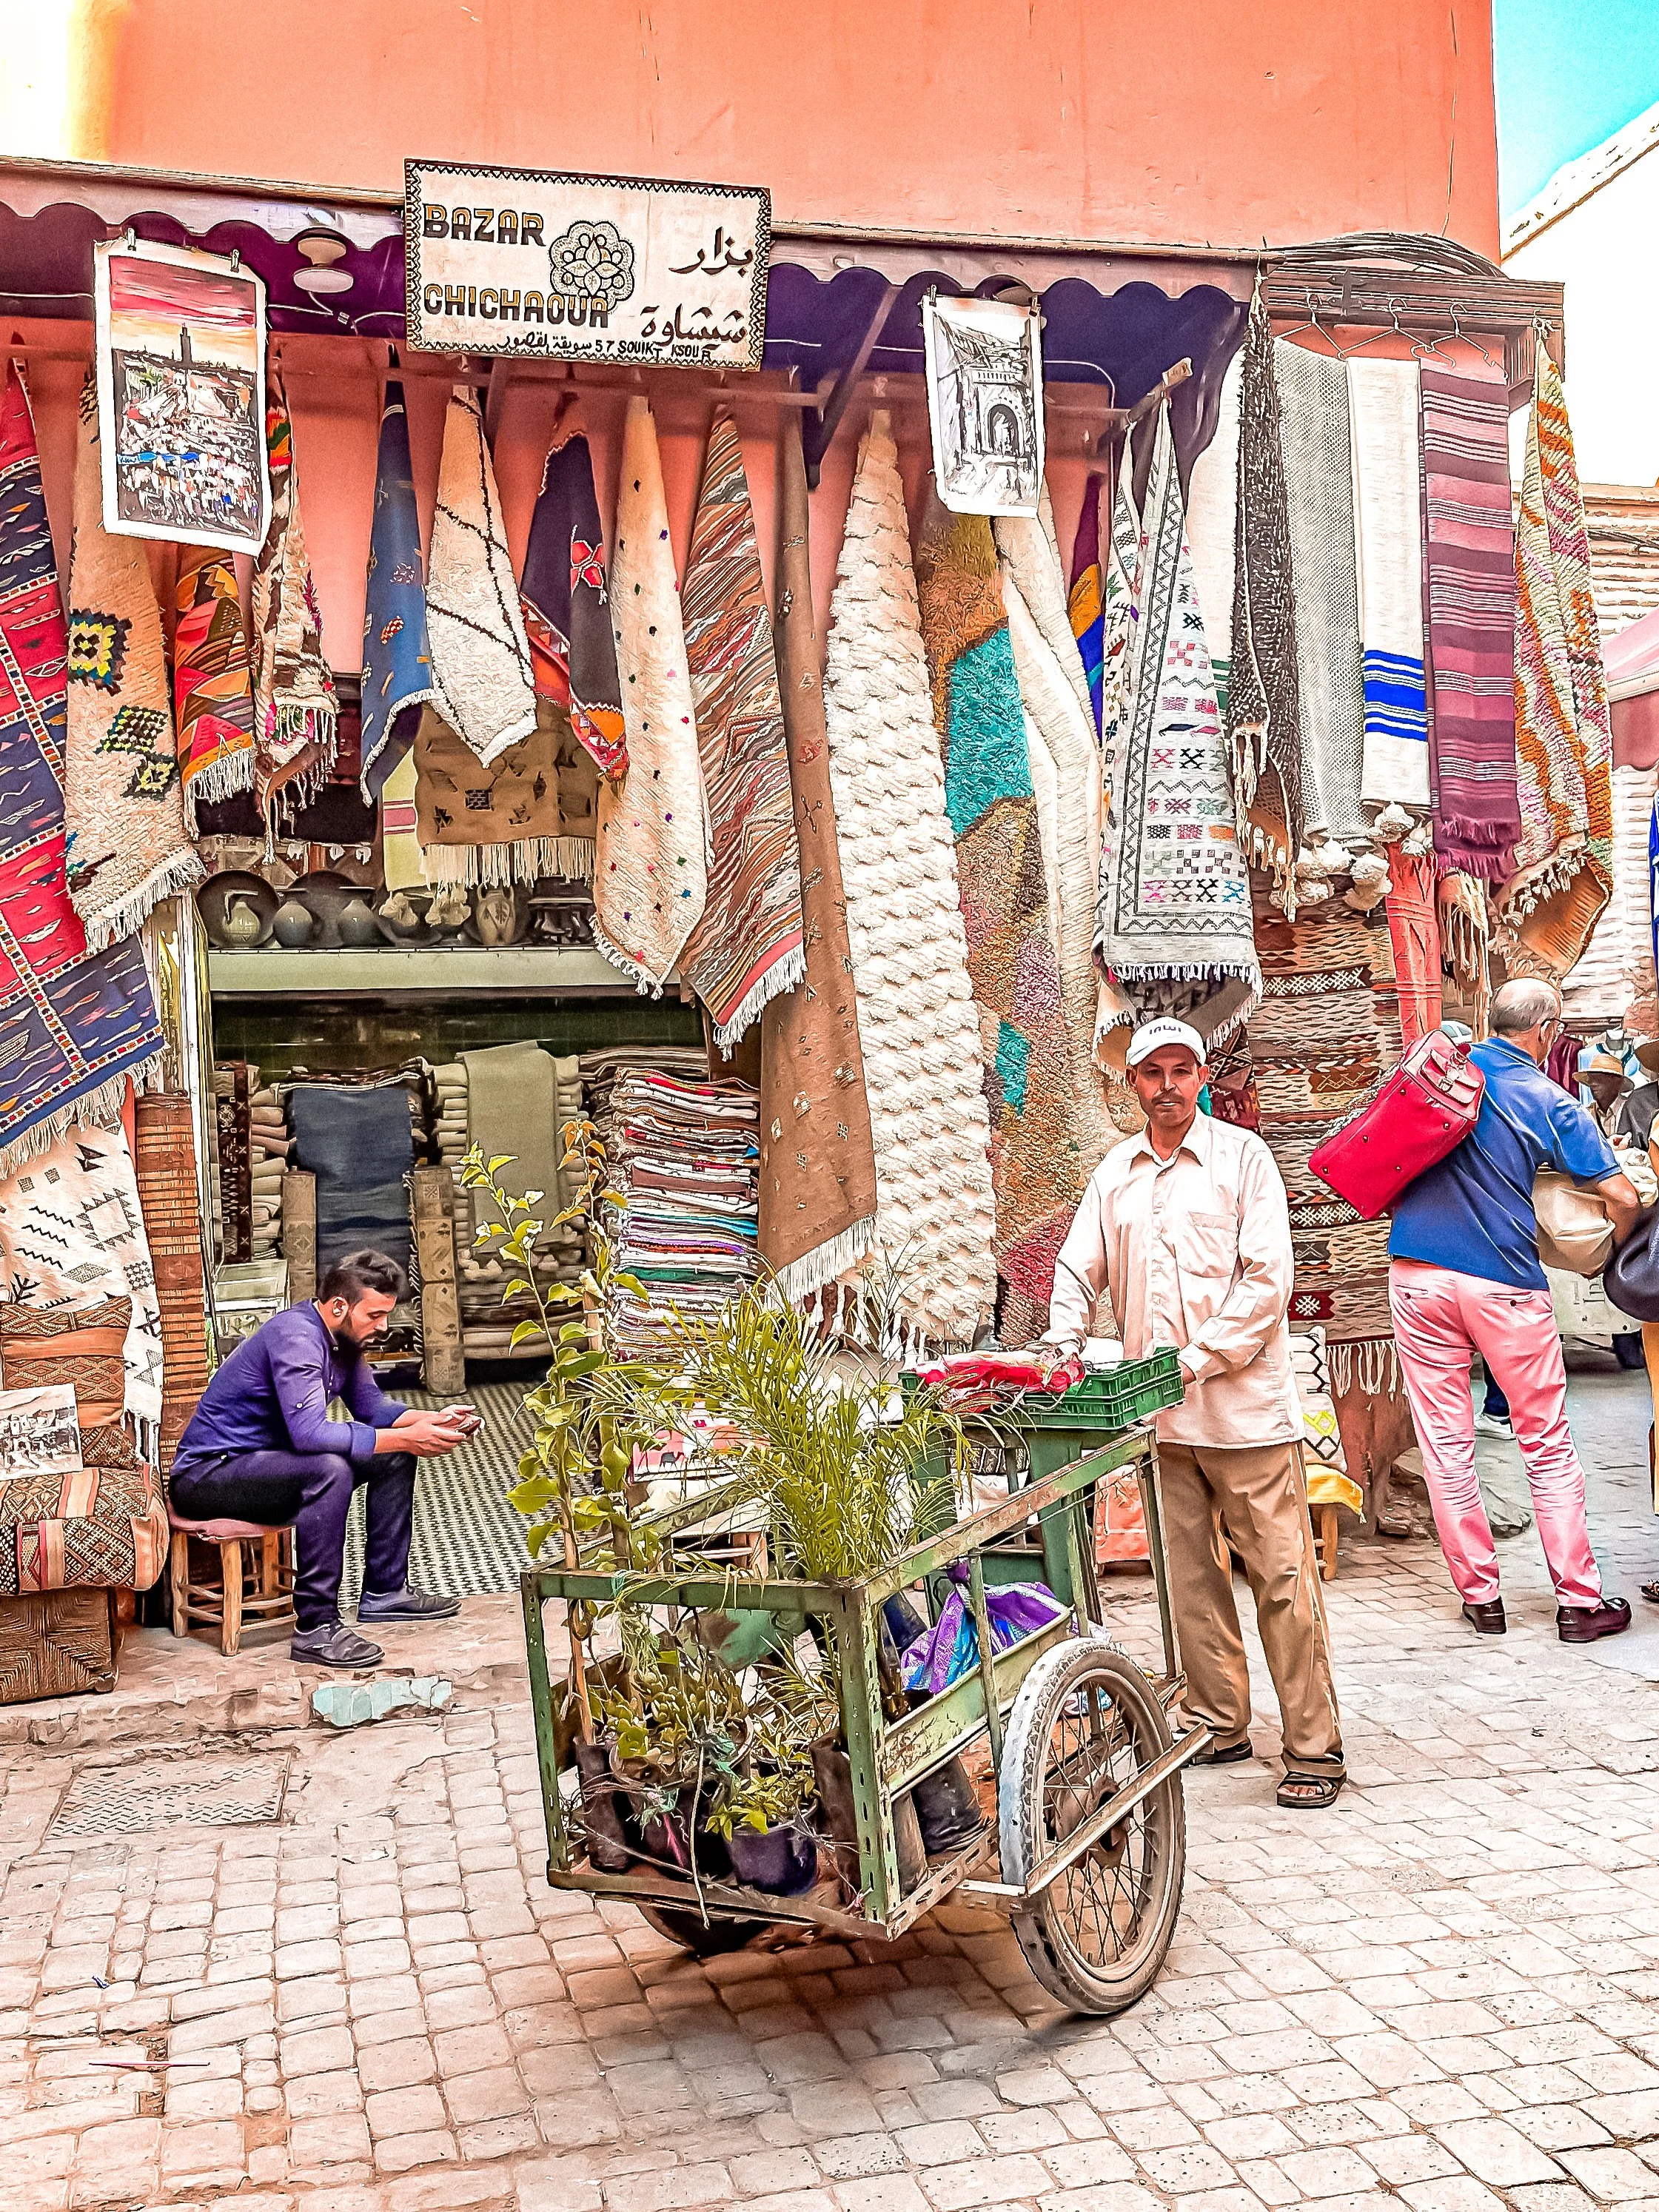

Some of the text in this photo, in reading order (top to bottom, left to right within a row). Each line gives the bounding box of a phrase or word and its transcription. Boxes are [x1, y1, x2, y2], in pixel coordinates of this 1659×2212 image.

[422, 203, 546, 247] BAZAR
[668, 226, 754, 278] بزار
[423, 283, 609, 328] CHICHAOUA
